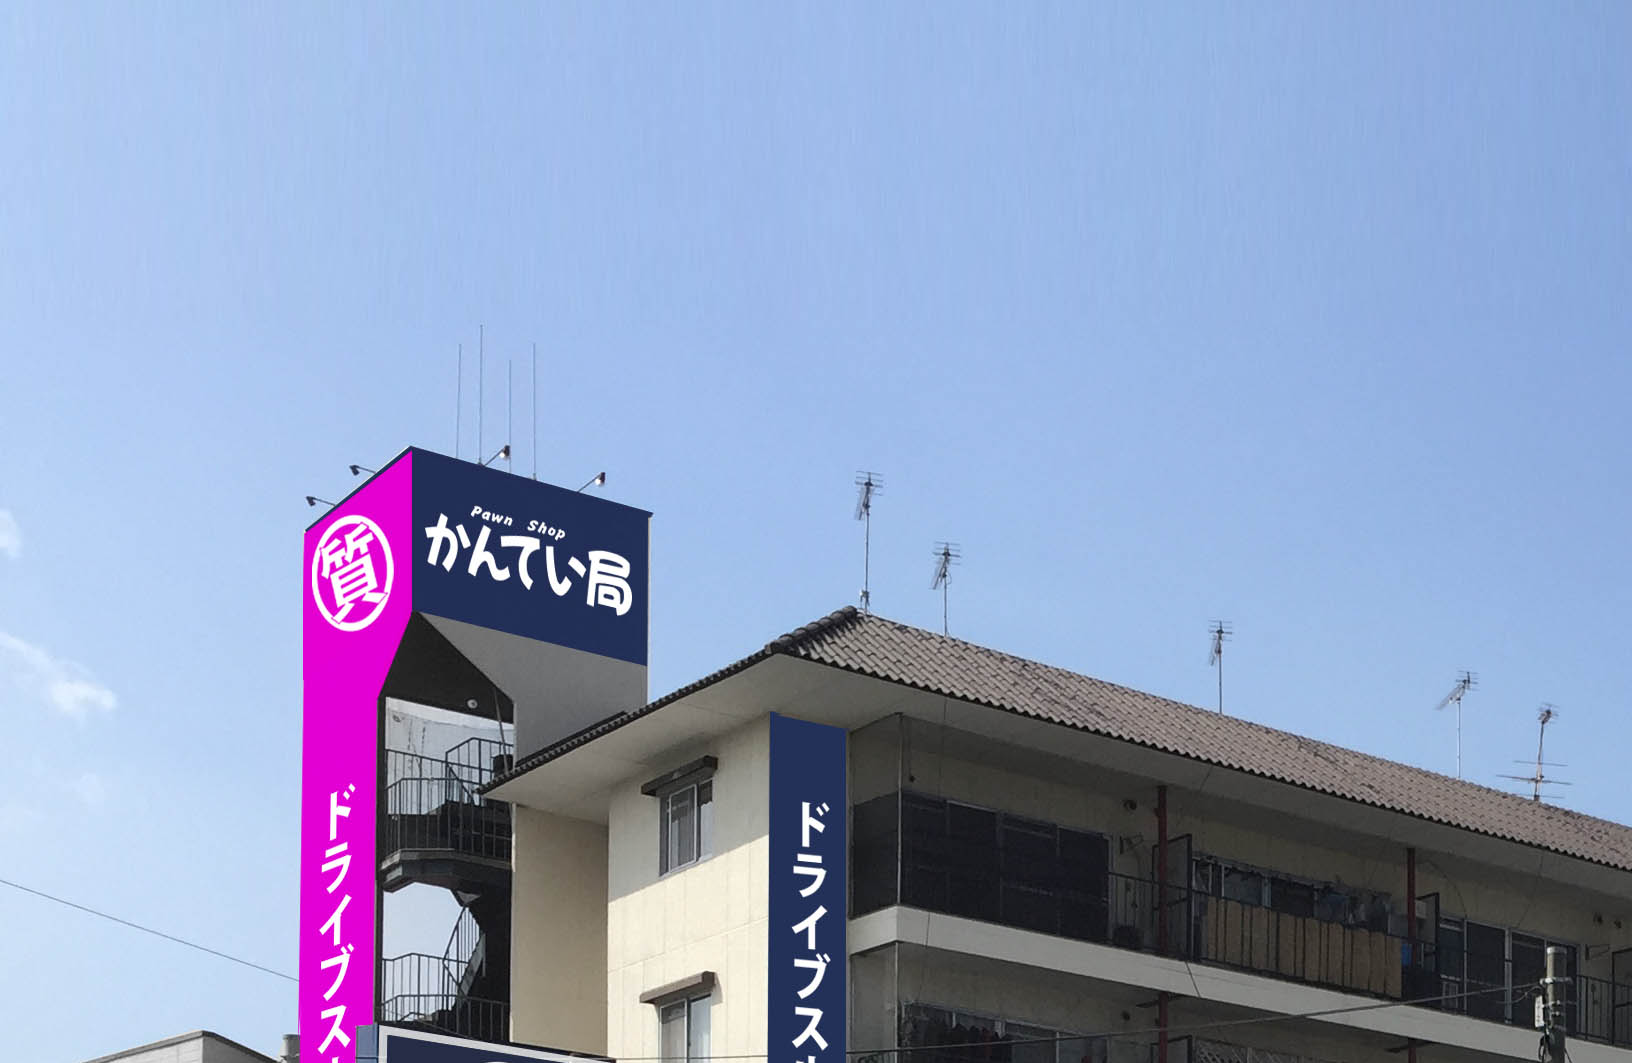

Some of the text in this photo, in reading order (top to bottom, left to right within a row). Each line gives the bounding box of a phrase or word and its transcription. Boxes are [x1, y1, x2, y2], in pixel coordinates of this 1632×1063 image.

[319, 521, 389, 625] 質
[425, 513, 633, 617] かんてい局
[470, 505, 567, 542] Pawn Shop
